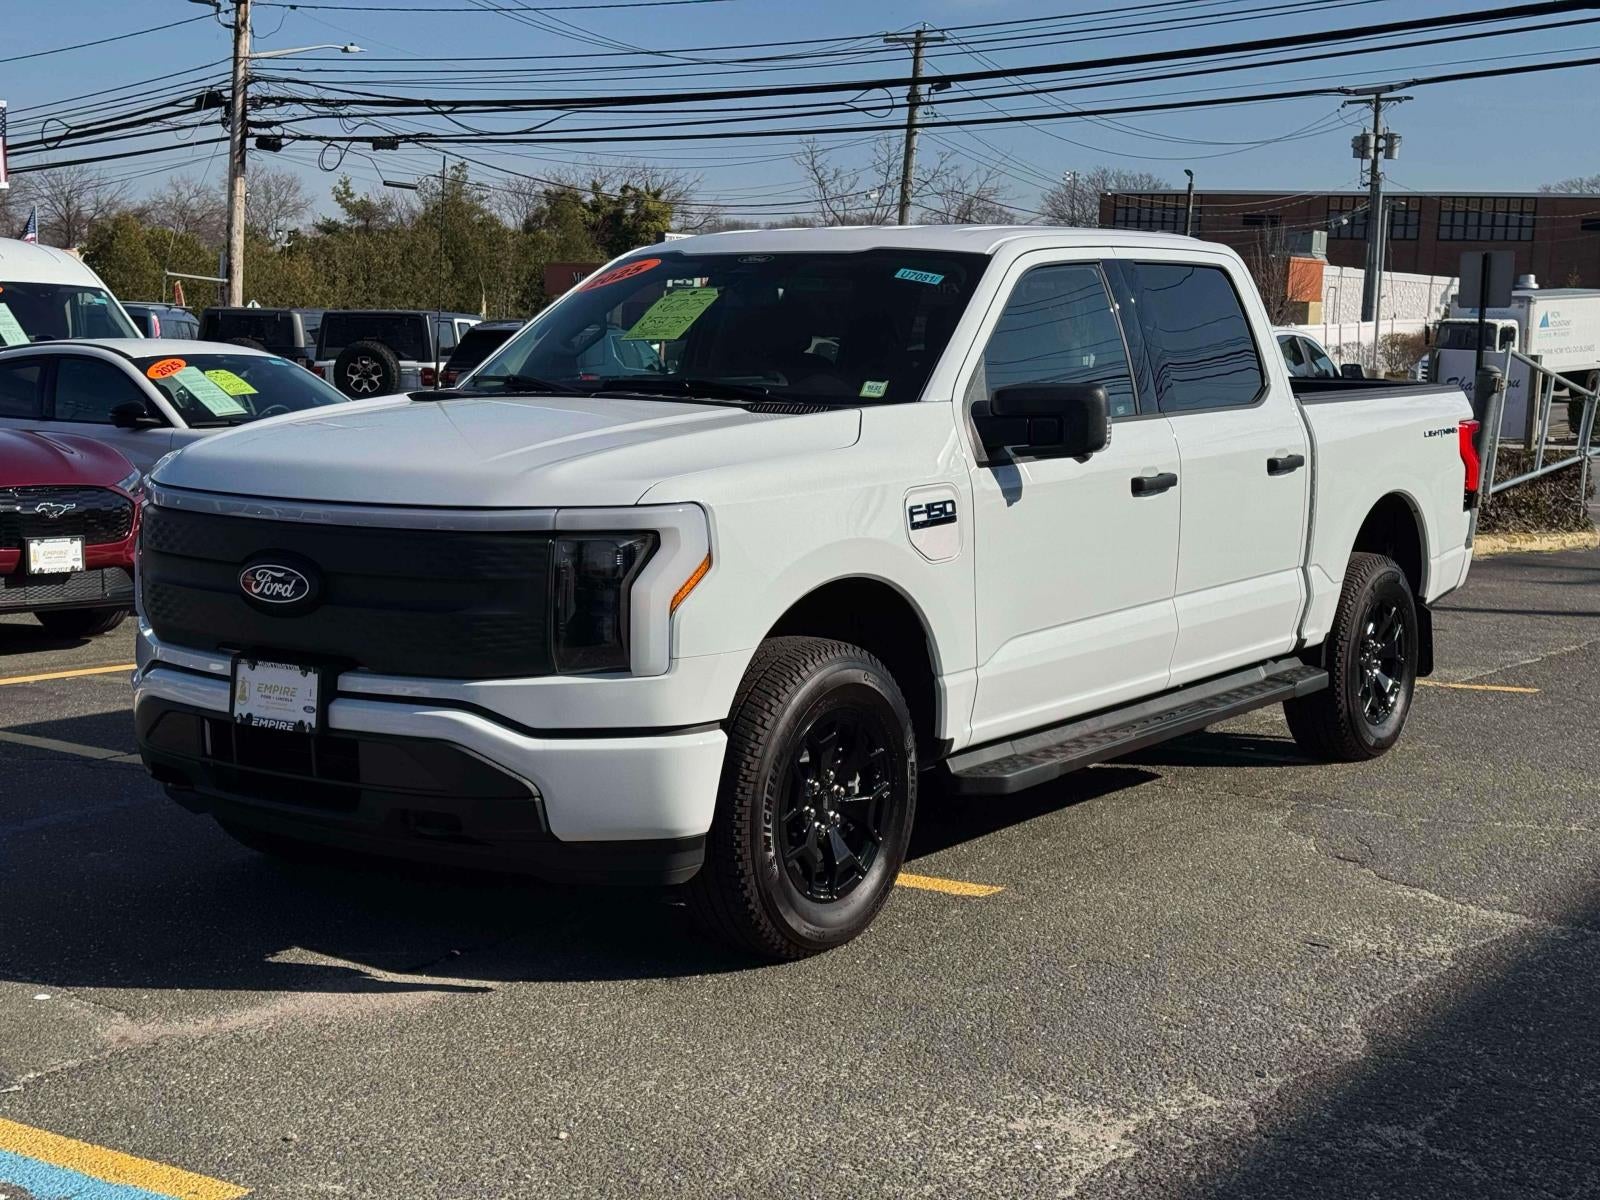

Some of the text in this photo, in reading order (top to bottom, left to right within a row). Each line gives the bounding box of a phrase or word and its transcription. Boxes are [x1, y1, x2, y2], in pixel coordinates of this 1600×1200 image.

[155, 361, 182, 376] 2025
[1423, 427, 1457, 438] LIGHTNING
[908, 499, 957, 529] F-150
[251, 569, 296, 597] Ford
[256, 682, 299, 698] EMPIRE
[251, 716, 295, 732] EMPIRE
[762, 751, 782, 853] MICHELIN
